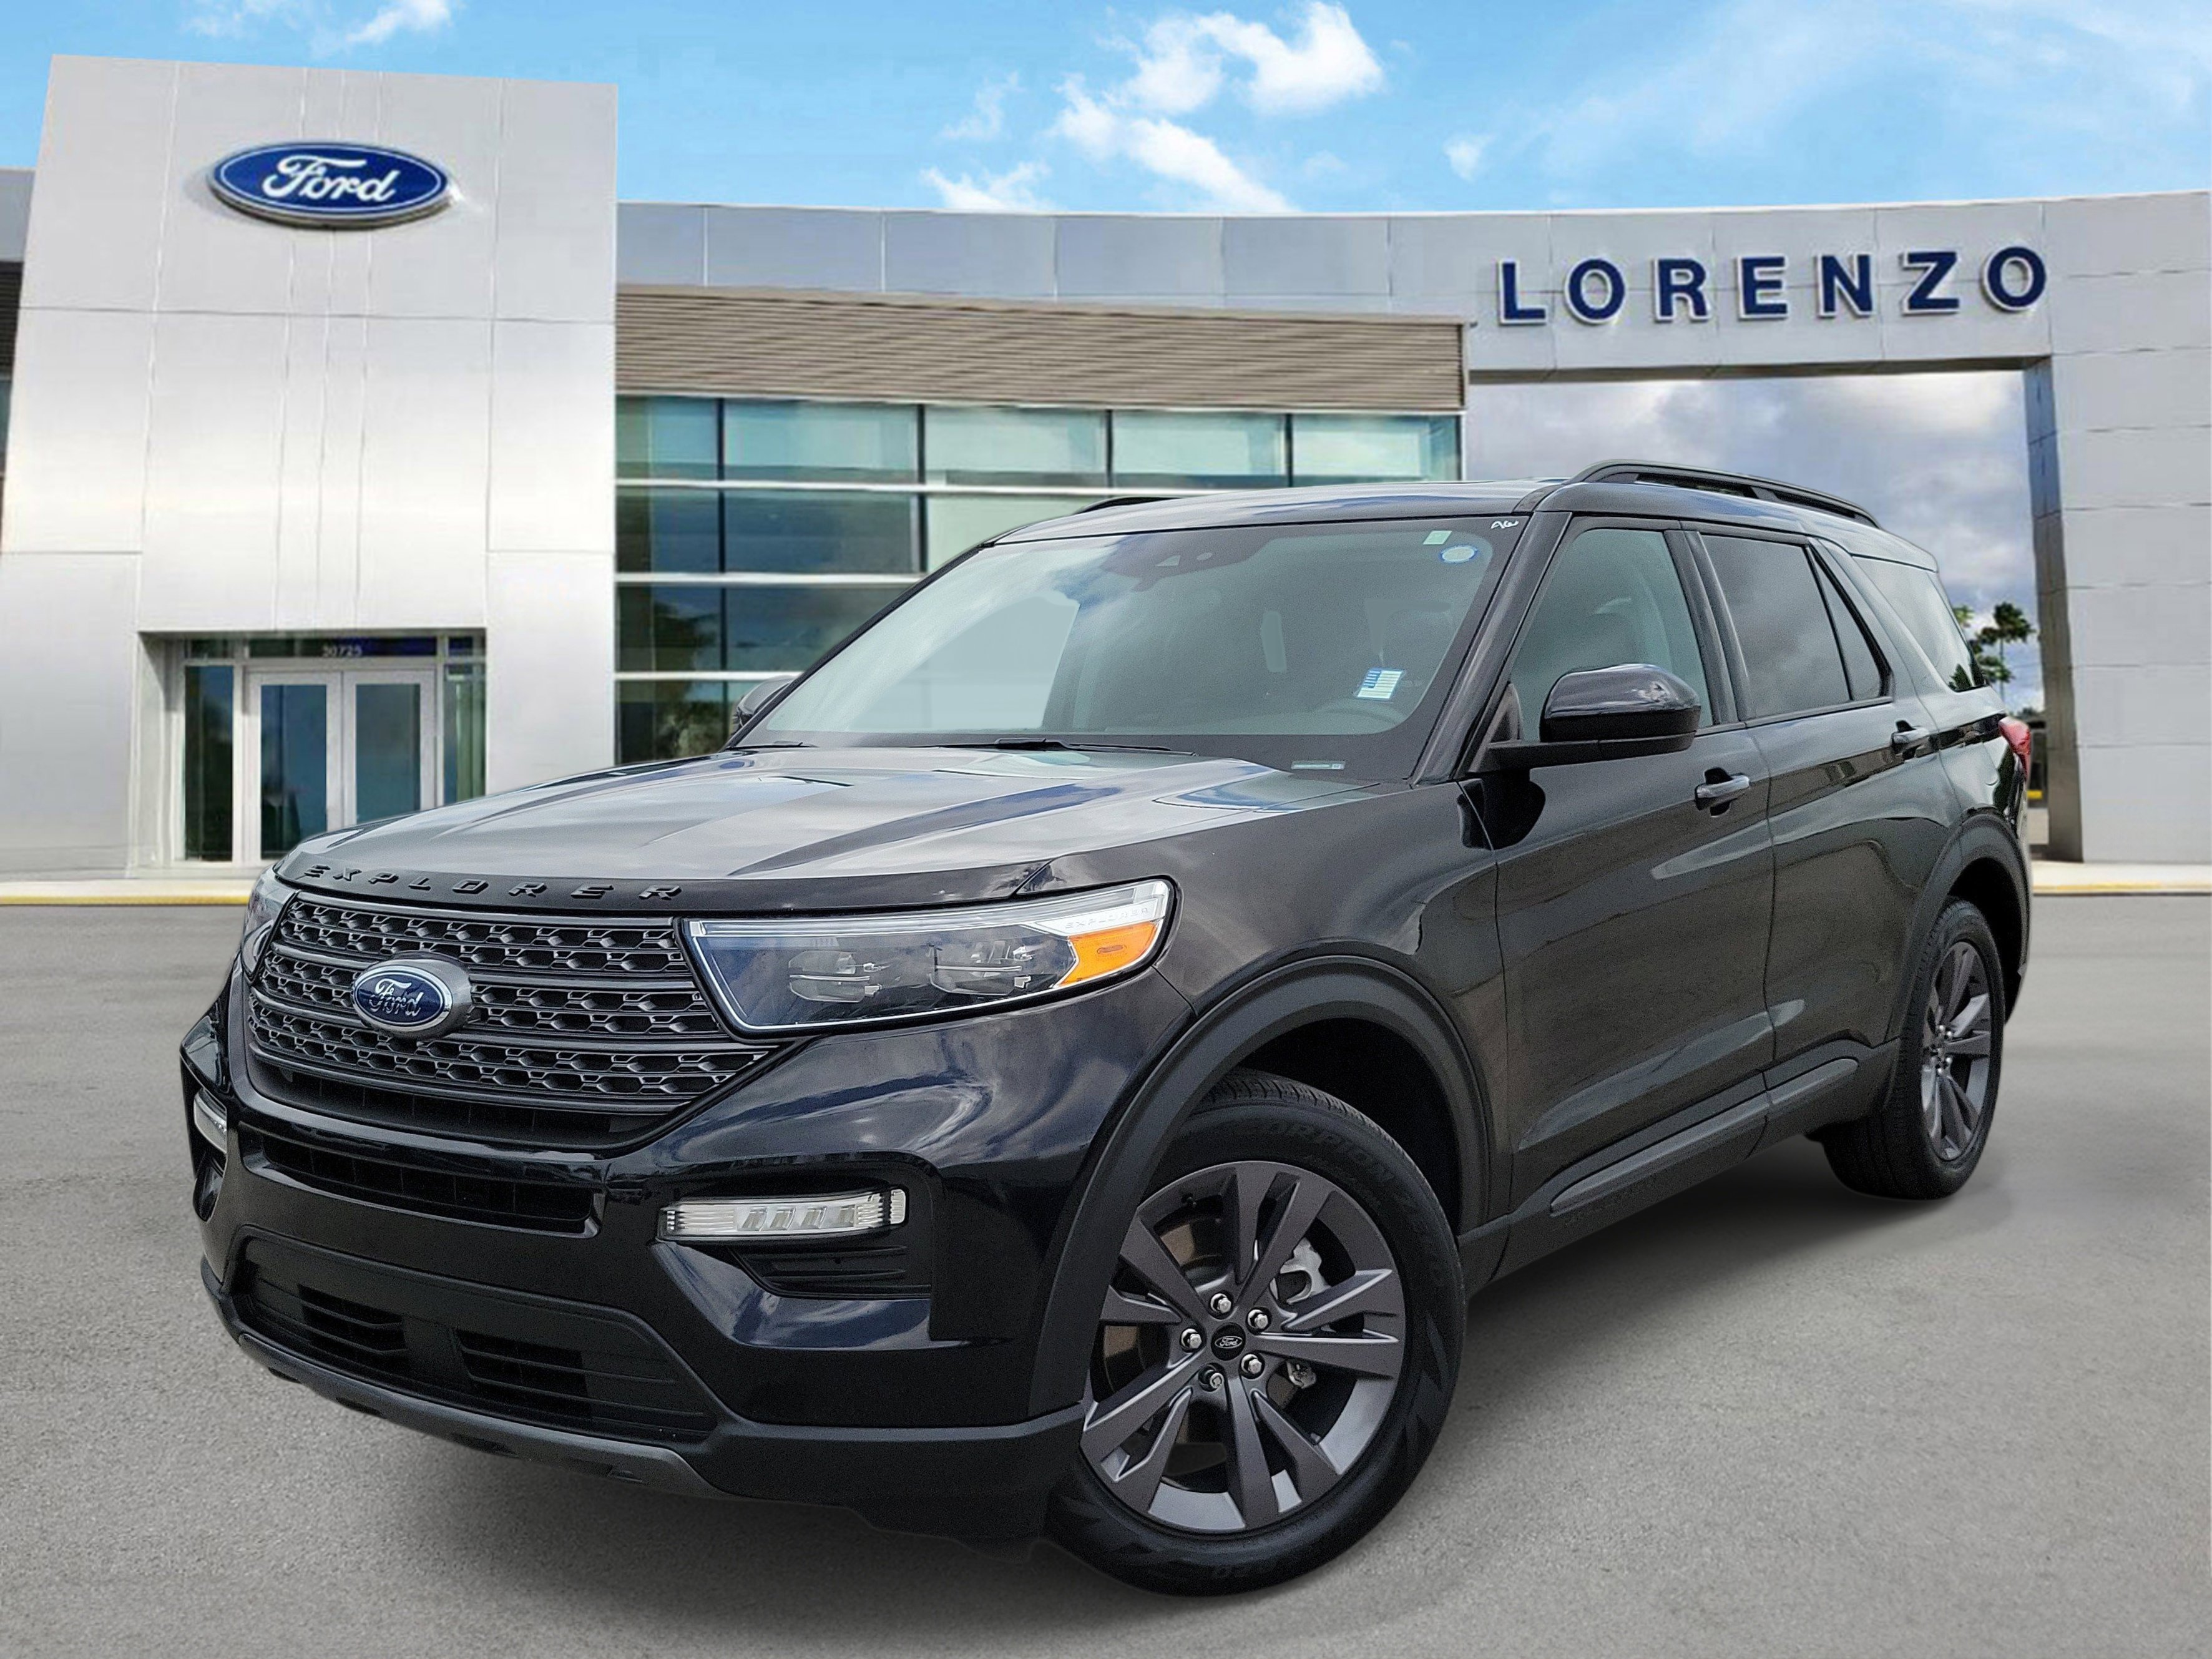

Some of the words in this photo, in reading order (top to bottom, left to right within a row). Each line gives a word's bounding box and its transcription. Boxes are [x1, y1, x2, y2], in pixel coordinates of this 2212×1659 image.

[262, 155, 401, 202] Ford
[1500, 247, 2047, 322] LORENZO
[303, 863, 682, 901] EXPLORER
[367, 980, 422, 1019] Ford
[1219, 1336, 1240, 1346] Ford
